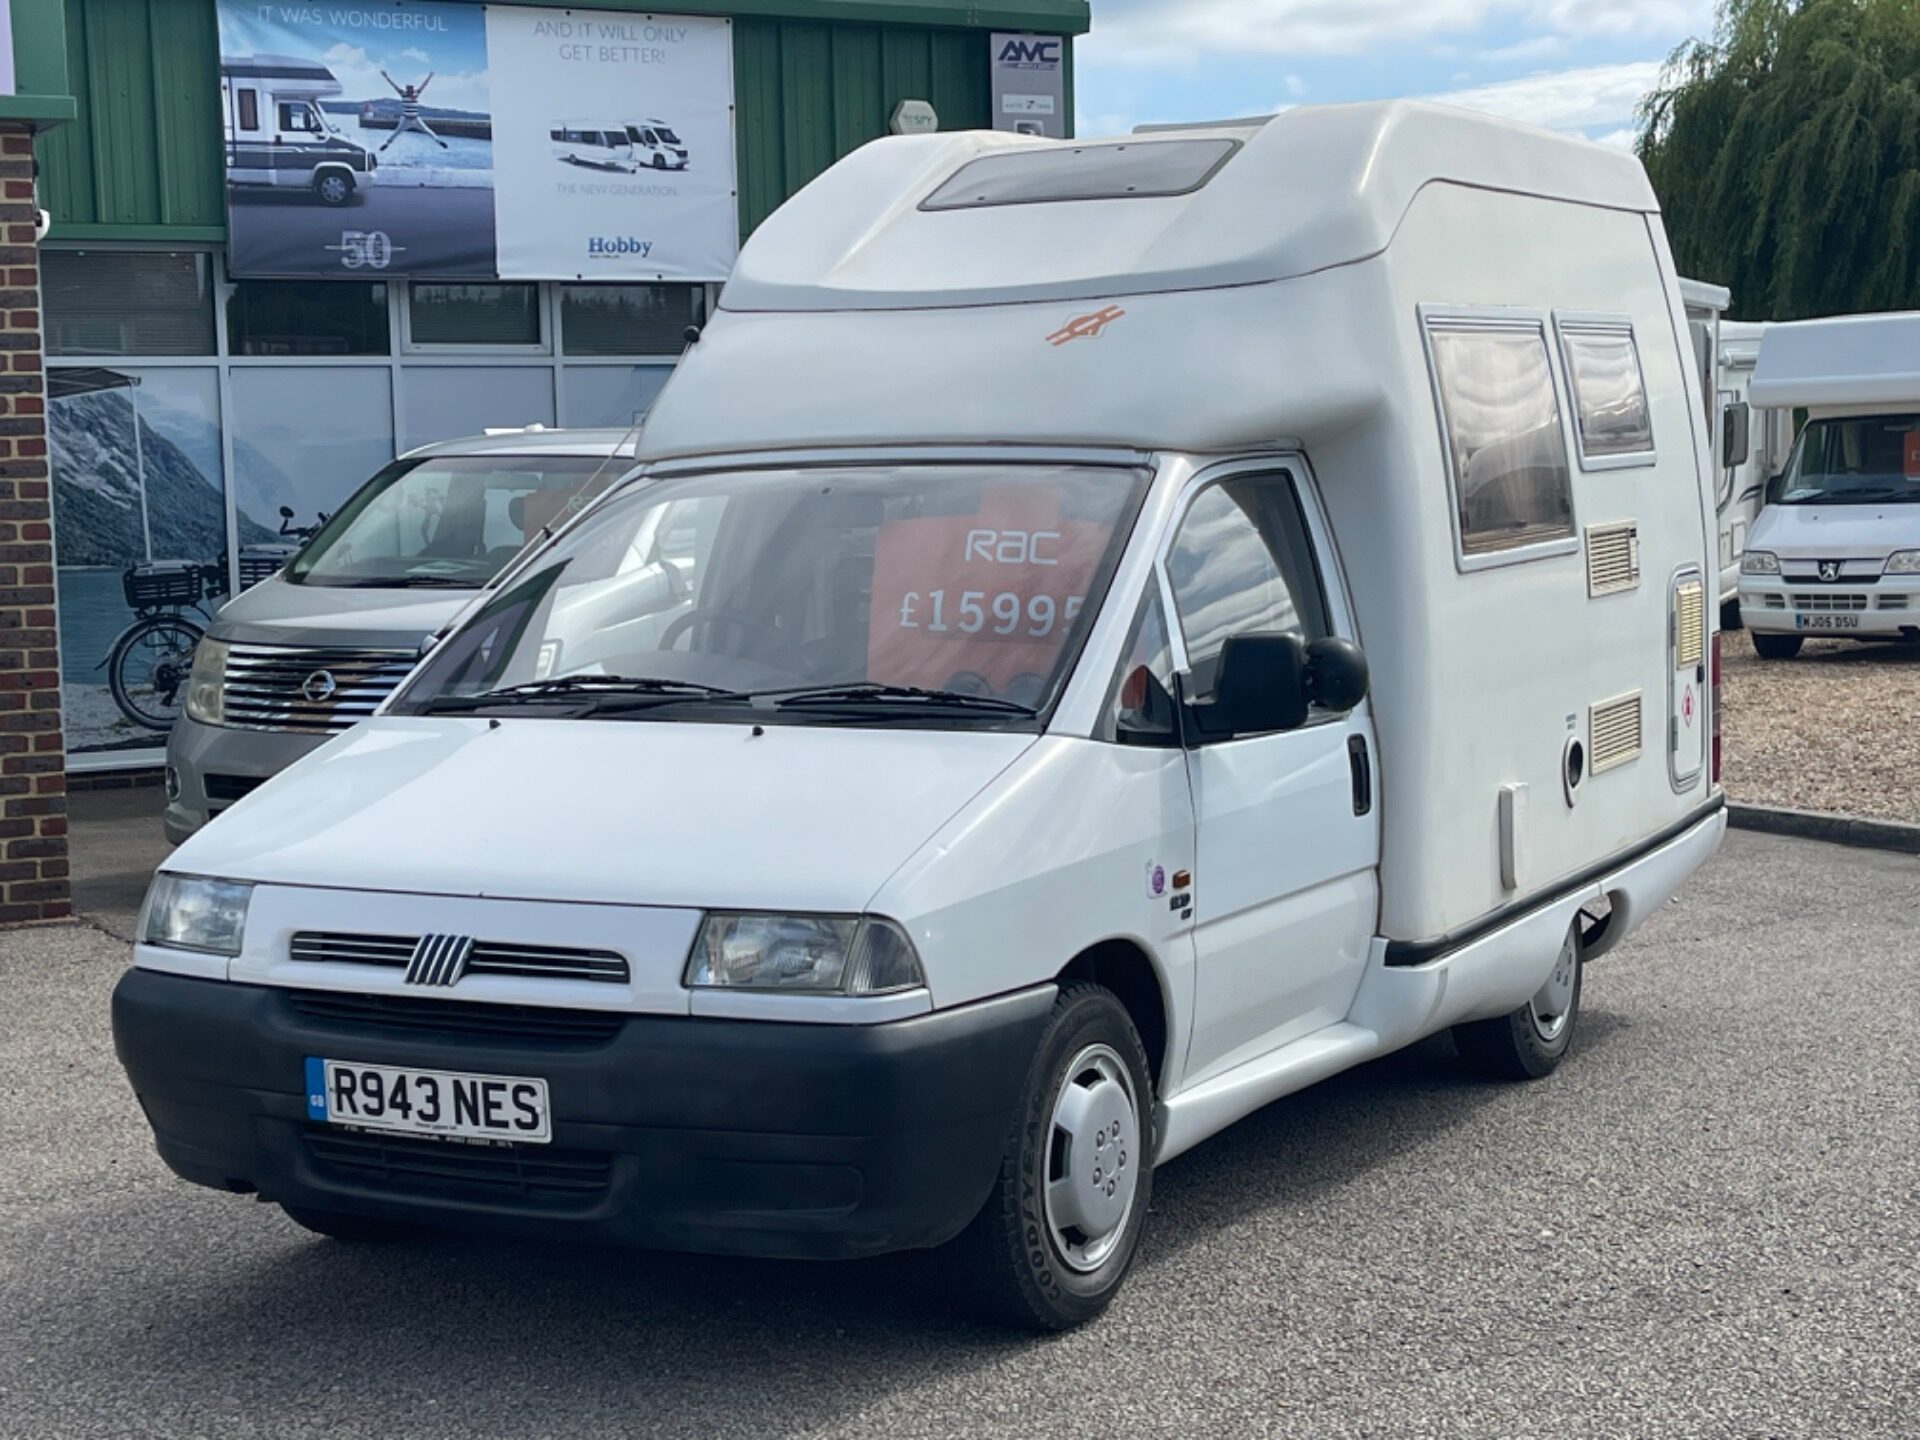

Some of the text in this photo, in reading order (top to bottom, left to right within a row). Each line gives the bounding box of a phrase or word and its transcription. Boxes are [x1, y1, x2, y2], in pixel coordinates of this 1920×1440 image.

[258, 5, 448, 32] IT WAS WONDERFUL
[534, 21, 688, 43] AND IT WILL ONLY
[559, 44, 666, 64] GET BETTER!
[555, 182, 678, 196] THE NEW GENERATION
[588, 235, 654, 259] Hobby
[333, 1067, 540, 1131] R943 NES
